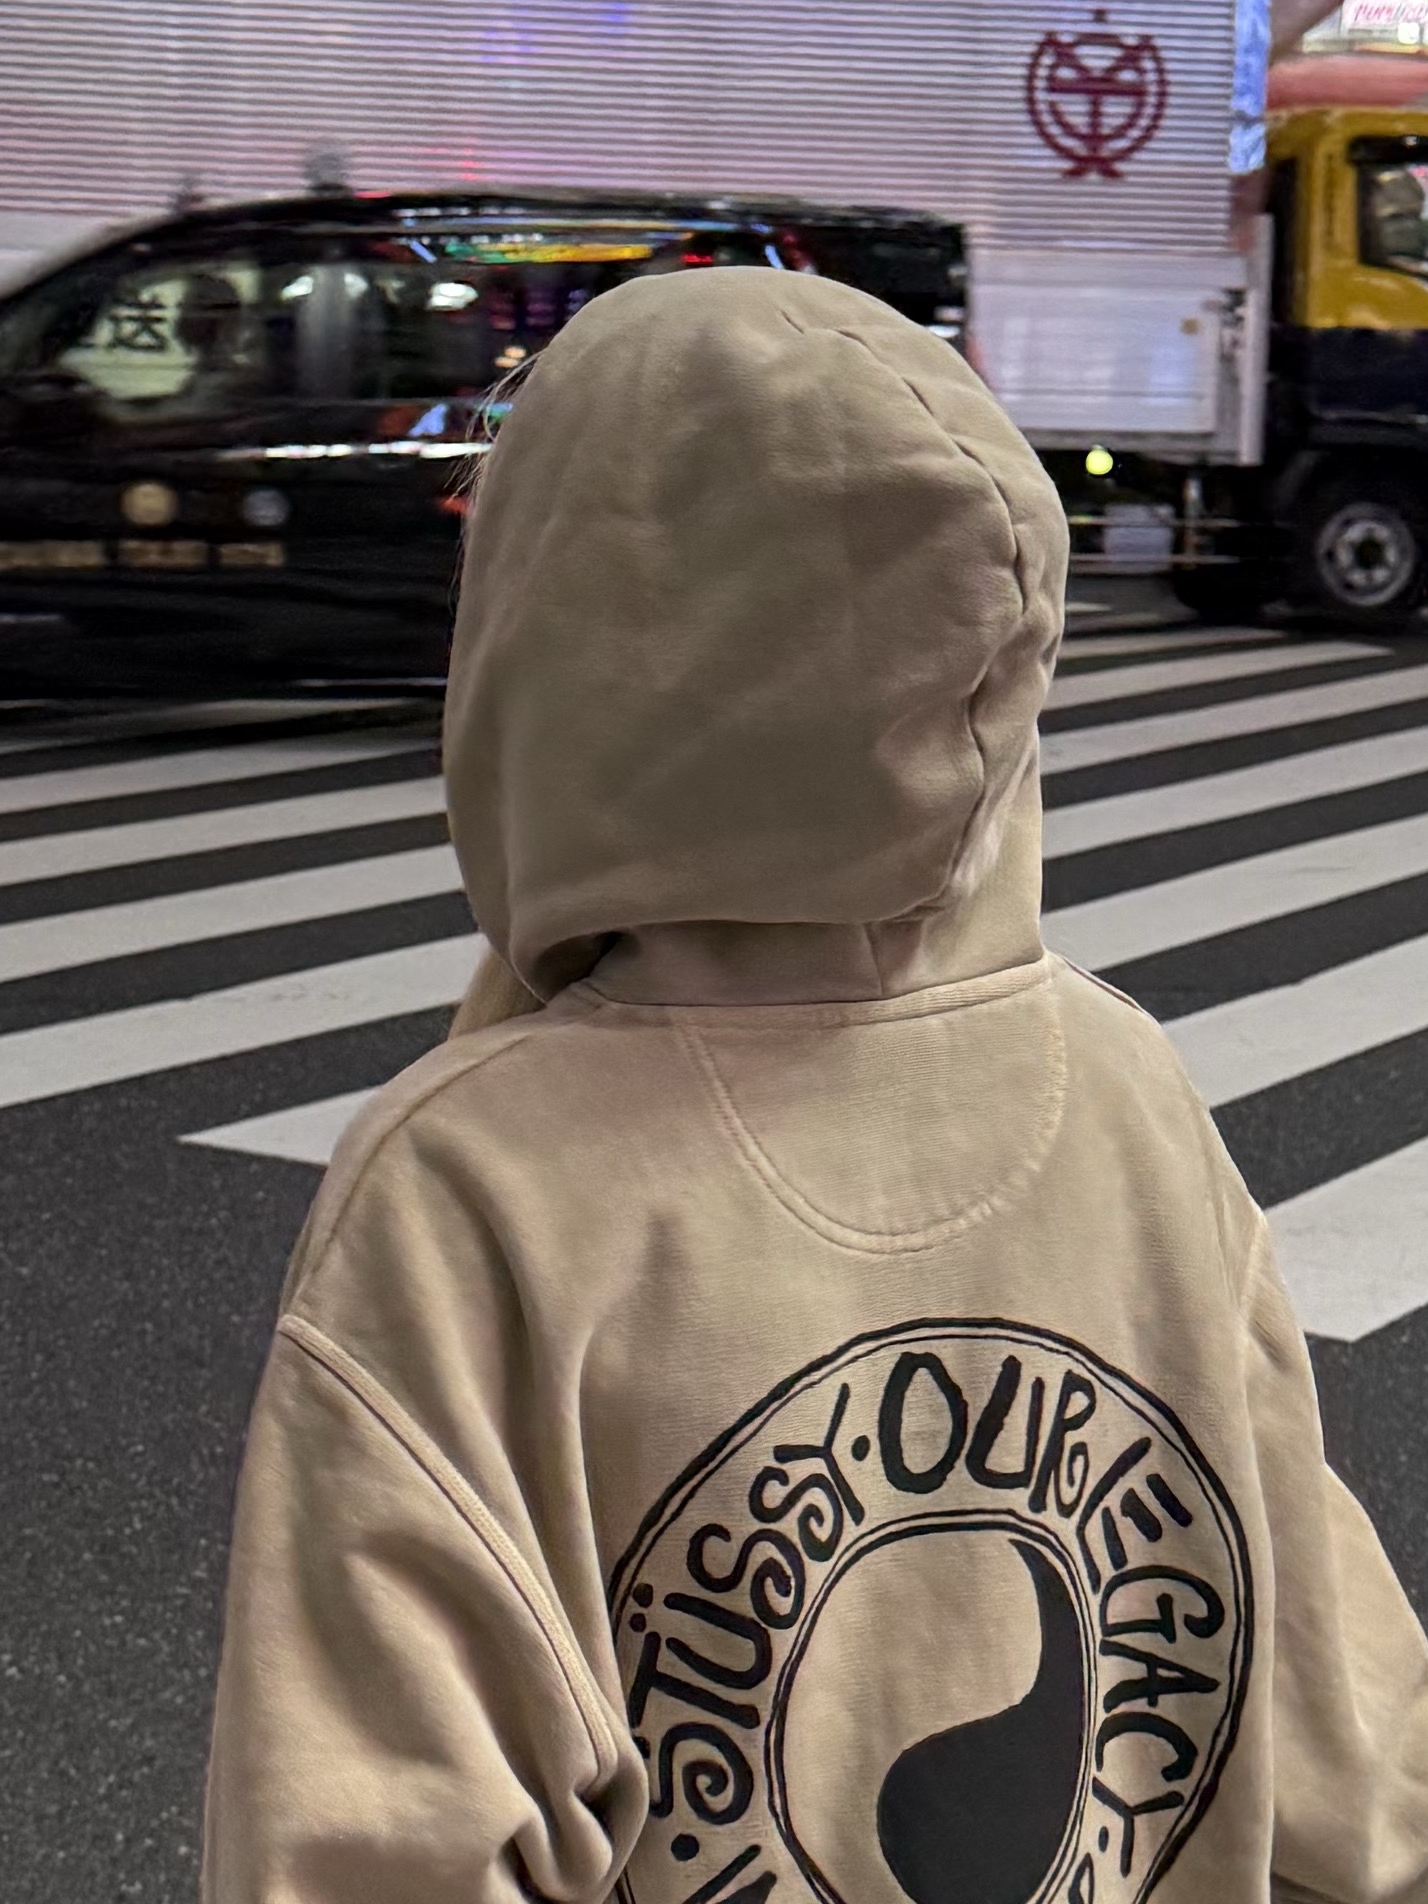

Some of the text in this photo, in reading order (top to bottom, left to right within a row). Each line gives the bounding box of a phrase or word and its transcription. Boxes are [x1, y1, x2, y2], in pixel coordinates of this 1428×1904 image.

[628, 1351, 1226, 1878] STÜSSY OUR LEGACY
